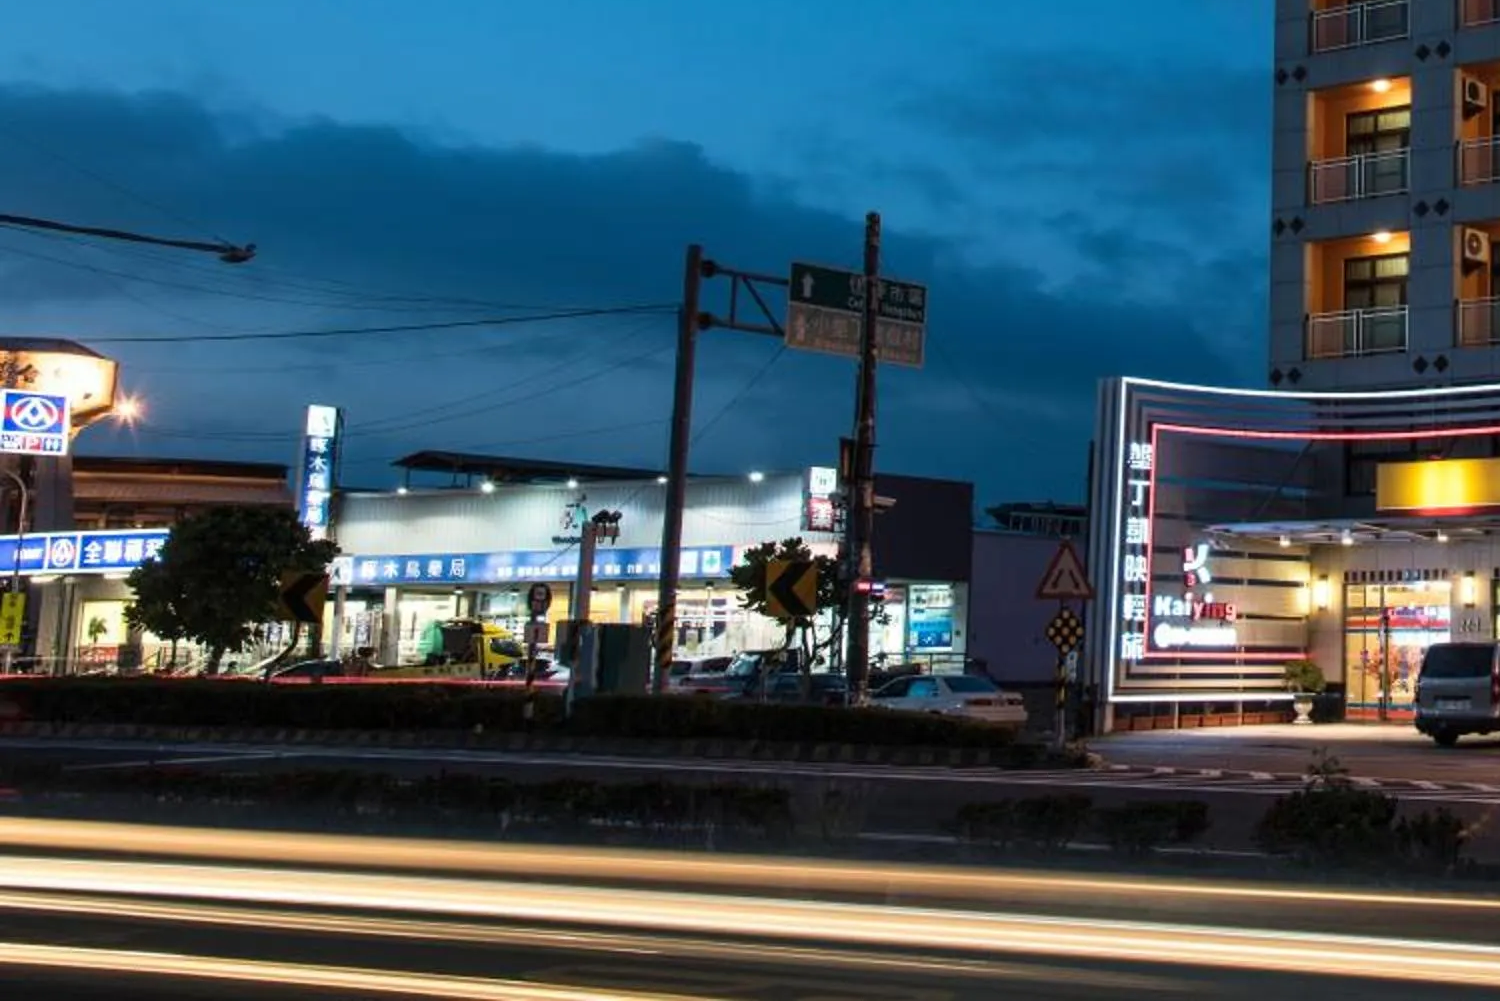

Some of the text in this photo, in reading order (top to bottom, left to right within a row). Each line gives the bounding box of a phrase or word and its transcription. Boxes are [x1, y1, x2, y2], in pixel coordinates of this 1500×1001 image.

[1121, 442, 1153, 660] 墾丁凱映輕旅
[1154, 592, 1237, 623] Kaiying
